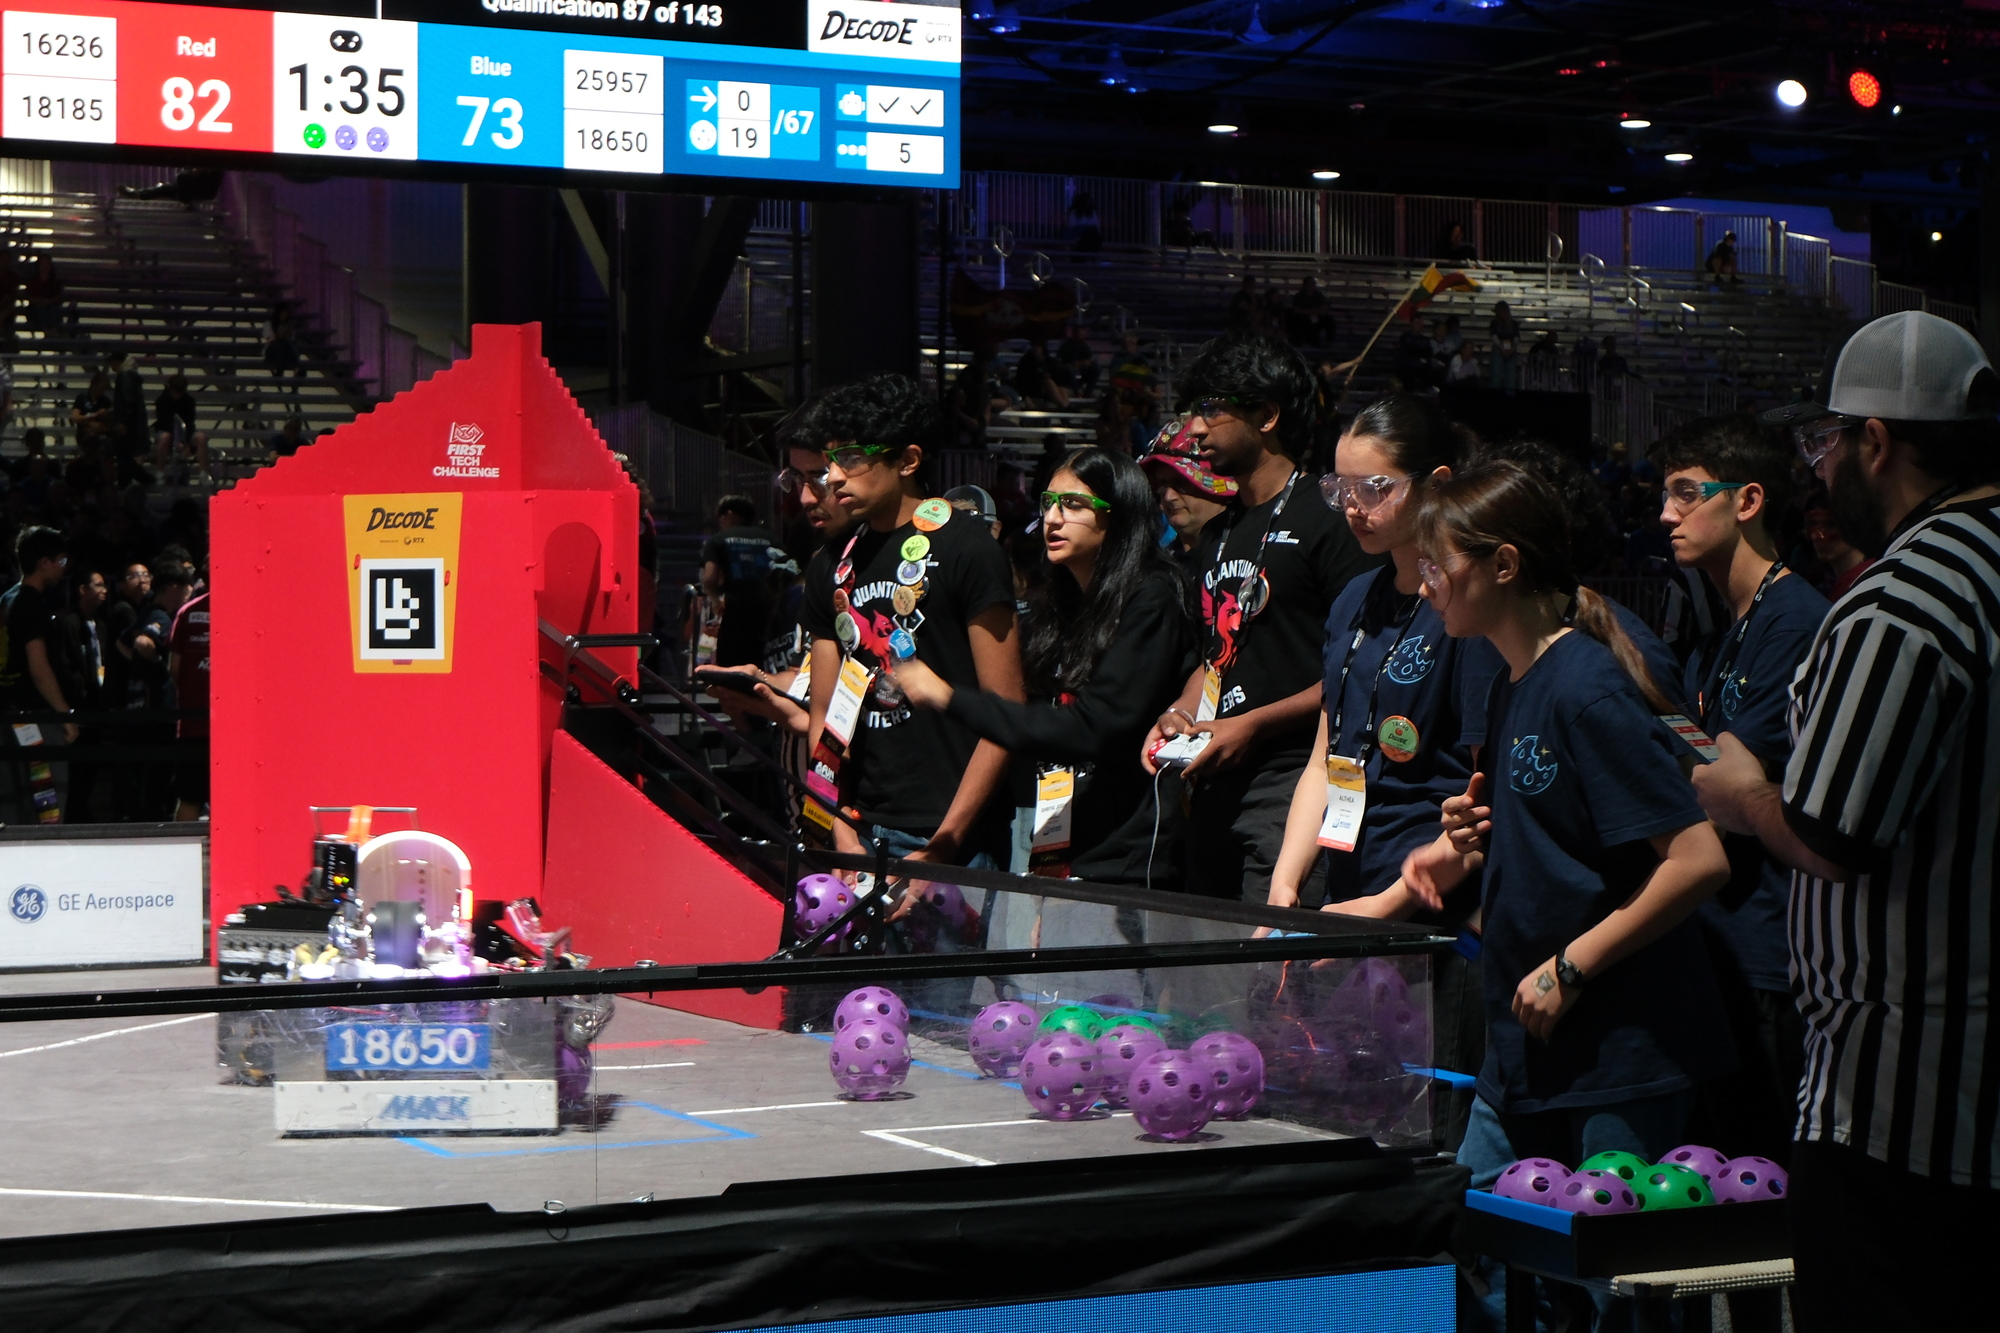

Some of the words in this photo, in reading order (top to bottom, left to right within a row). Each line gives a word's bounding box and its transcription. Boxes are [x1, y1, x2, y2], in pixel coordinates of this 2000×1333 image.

[482, 0, 618, 19] Qualification
[623, 0, 650, 21] 87
[655, 2, 679, 24] of
[682, 4, 723, 27] 143
[22, 32, 103, 59] 16236
[177, 36, 216, 57] Red
[470, 57, 512, 77] Blue
[288, 63, 406, 117] 1:35
[576, 69, 648, 94] 25957
[22, 95, 103, 122] 18185
[161, 77, 233, 133] 82
[737, 90, 751, 111] 0
[456, 96, 525, 150] 73
[774, 110, 814, 135] /67
[577, 129, 648, 153] 18650
[731, 128, 758, 149] 19
[899, 142, 912, 164] 5
[447, 444, 486, 456] FIRST
[450, 456, 481, 466] TECH
[433, 466, 500, 478] CHALLENGE
[366, 507, 439, 532] DECODE
[1205, 558, 1257, 590] QANTUM
[58, 894, 81, 911] GE
[85, 893, 175, 912] Aerospace
[339, 1027, 478, 1067] 18650
